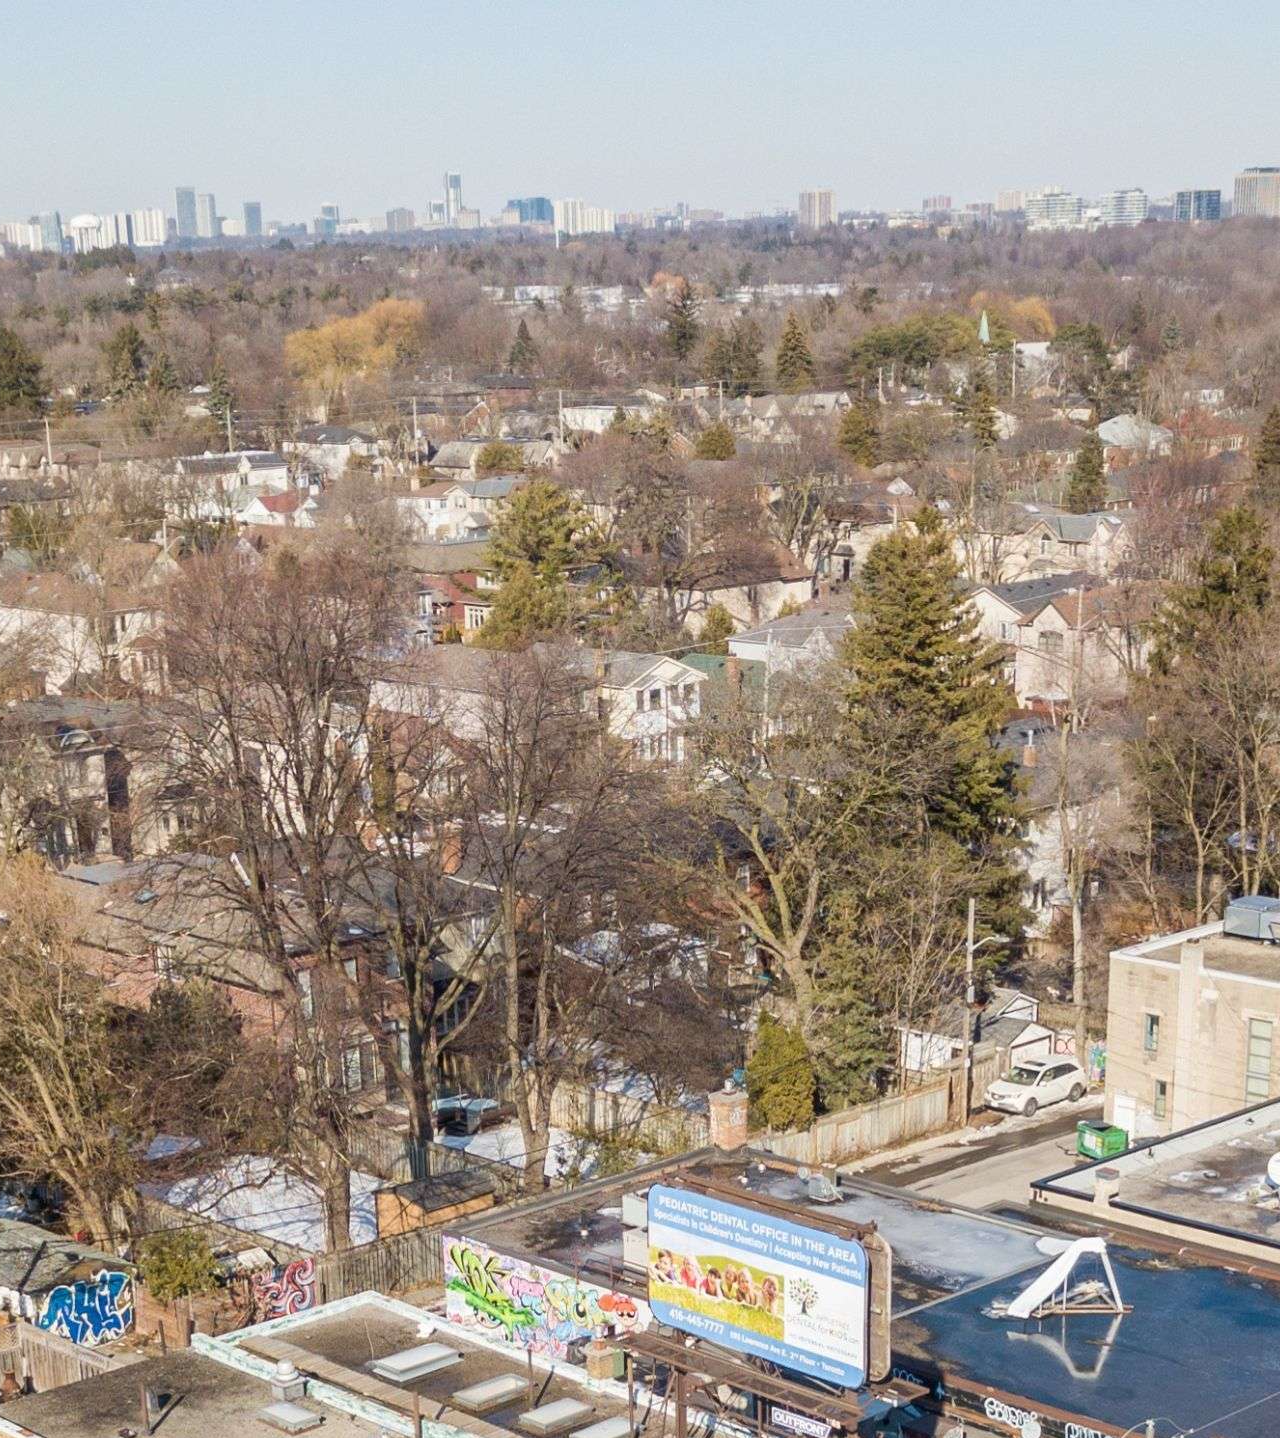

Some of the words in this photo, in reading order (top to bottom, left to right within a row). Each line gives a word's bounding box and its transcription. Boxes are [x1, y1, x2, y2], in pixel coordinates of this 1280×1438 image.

[653, 1208, 690, 1228] Specialists
[699, 1219, 734, 1240] Children's
[735, 1232, 769, 1252] Dentistry
[775, 1246, 812, 1266] Accepting
[813, 1257, 830, 1271] New
[831, 1262, 863, 1280] Patients
[659, 1194, 708, 1218] PEDIATRIC
[710, 1210, 749, 1232] DENTAL
[751, 1223, 789, 1244] OFFICE
[791, 1233, 803, 1248] IN
[804, 1237, 826, 1254] THE
[827, 1246, 857, 1264] AREA
[774, 1410, 827, 1438] OUTFRONT
